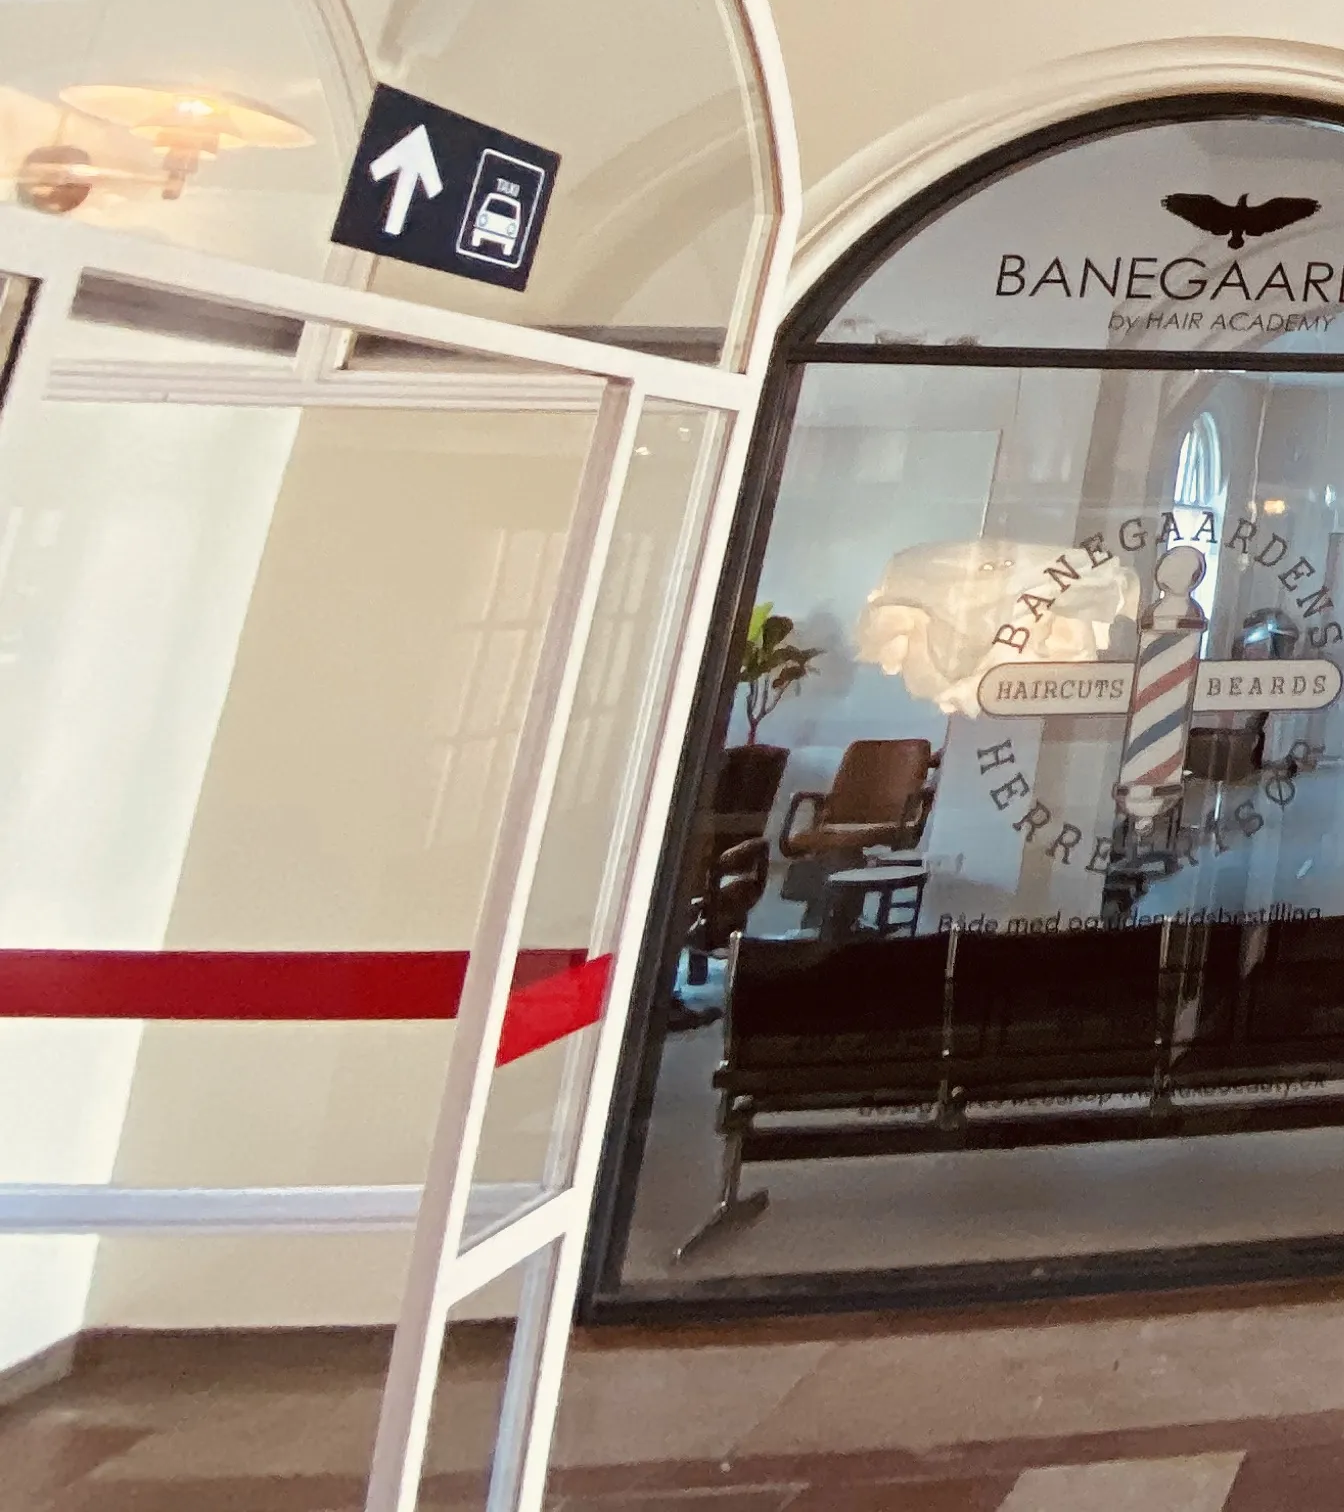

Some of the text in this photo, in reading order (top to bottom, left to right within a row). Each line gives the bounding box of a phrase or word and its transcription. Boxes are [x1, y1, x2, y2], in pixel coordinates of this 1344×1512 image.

[1108, 311, 1336, 333] by HAIR ACADEMY
[992, 511, 1344, 655] BANEGAARDENS
[995, 675, 1328, 701] HAIRCUTS BEARDS
[977, 739, 1327, 876] HERRERISØR
[1008, 908, 1062, 934] med
